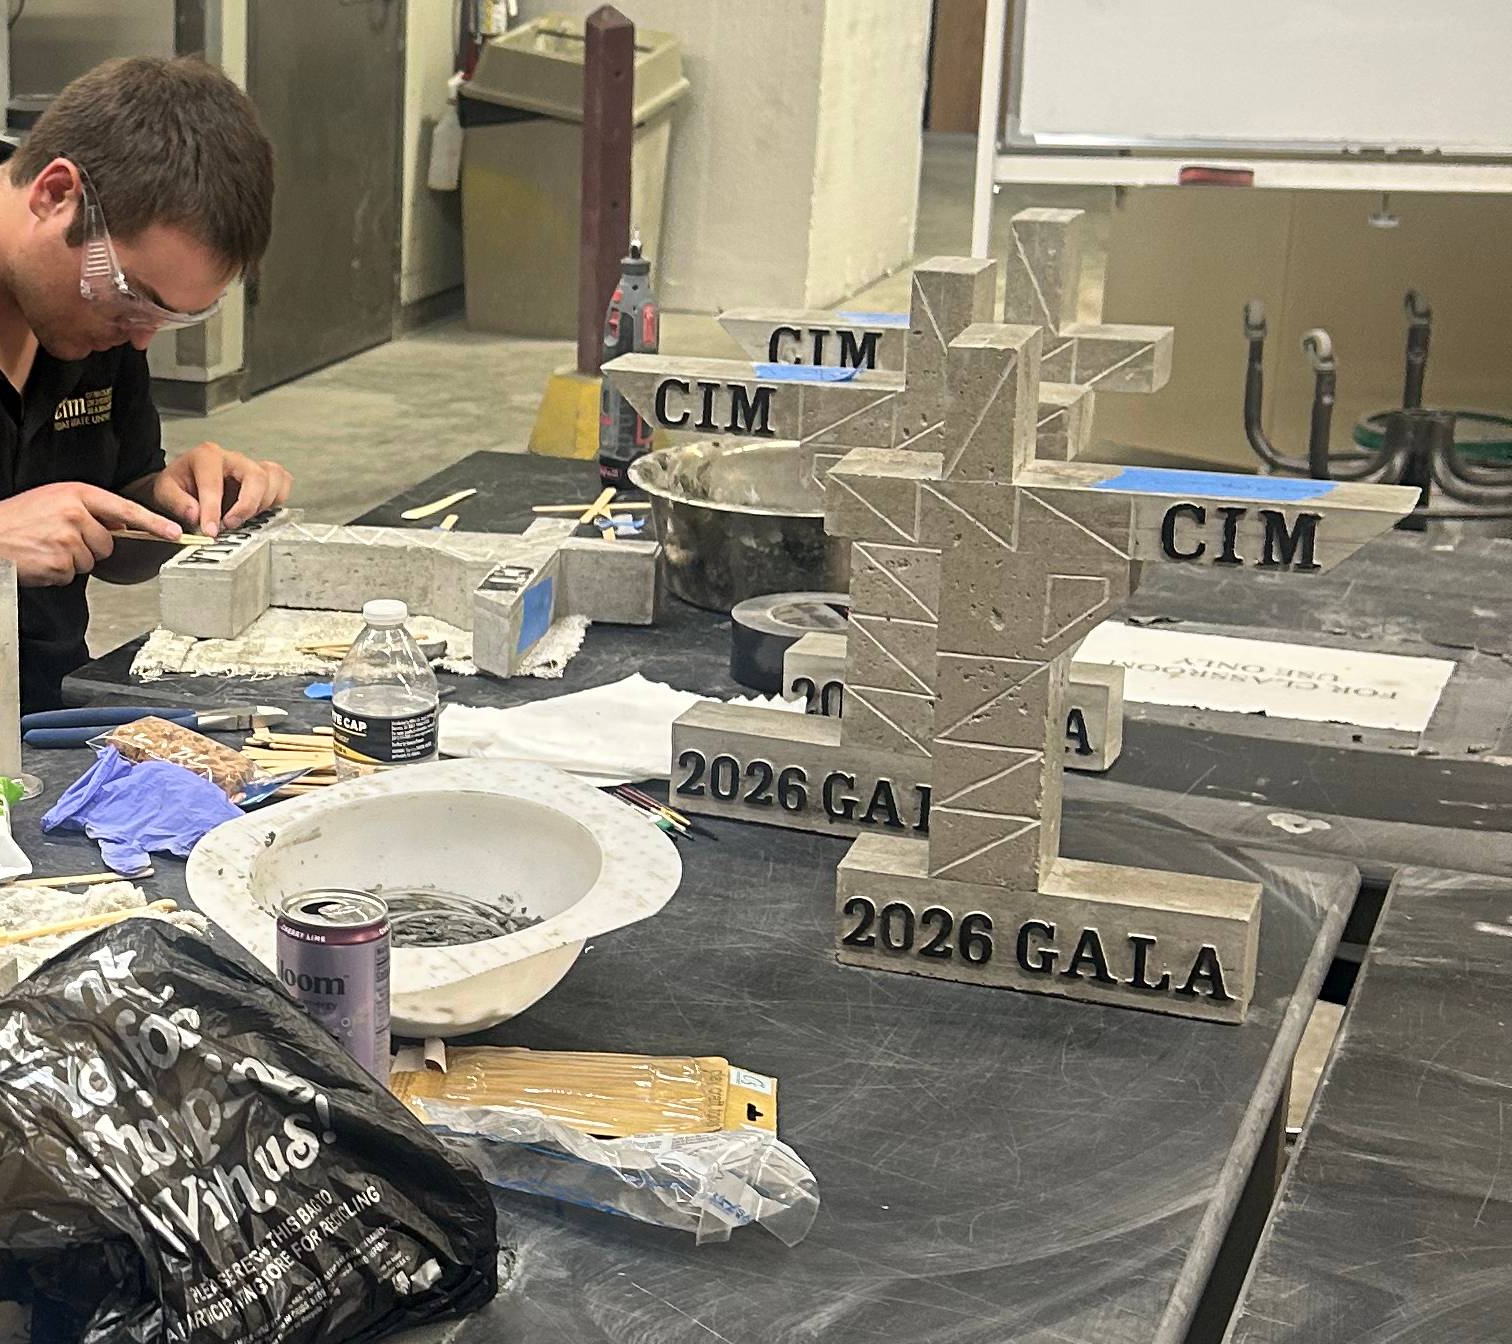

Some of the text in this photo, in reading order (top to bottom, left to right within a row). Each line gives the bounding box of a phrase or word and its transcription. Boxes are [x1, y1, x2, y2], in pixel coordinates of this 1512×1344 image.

[768, 324, 883, 370] CIM
[653, 378, 777, 438] CIM
[1160, 504, 1322, 571] CIM
[1178, 656, 1340, 682] USE ONLY
[1331, 686, 1399, 700] FOR
[343, 717, 368, 733] CAP
[676, 750, 809, 814] 2026
[306, 934, 326, 943] LIME
[842, 897, 1238, 1003] 2026 GALA
[278, 959, 345, 996] loom
[255, 1095, 337, 1181] us!
[265, 1215, 302, 1249] THIS
[296, 1198, 320, 1226] BAG
[316, 1189, 333, 1211] TO
[291, 1227, 323, 1259] FOR
[319, 1185, 381, 1237] RECYCLING
